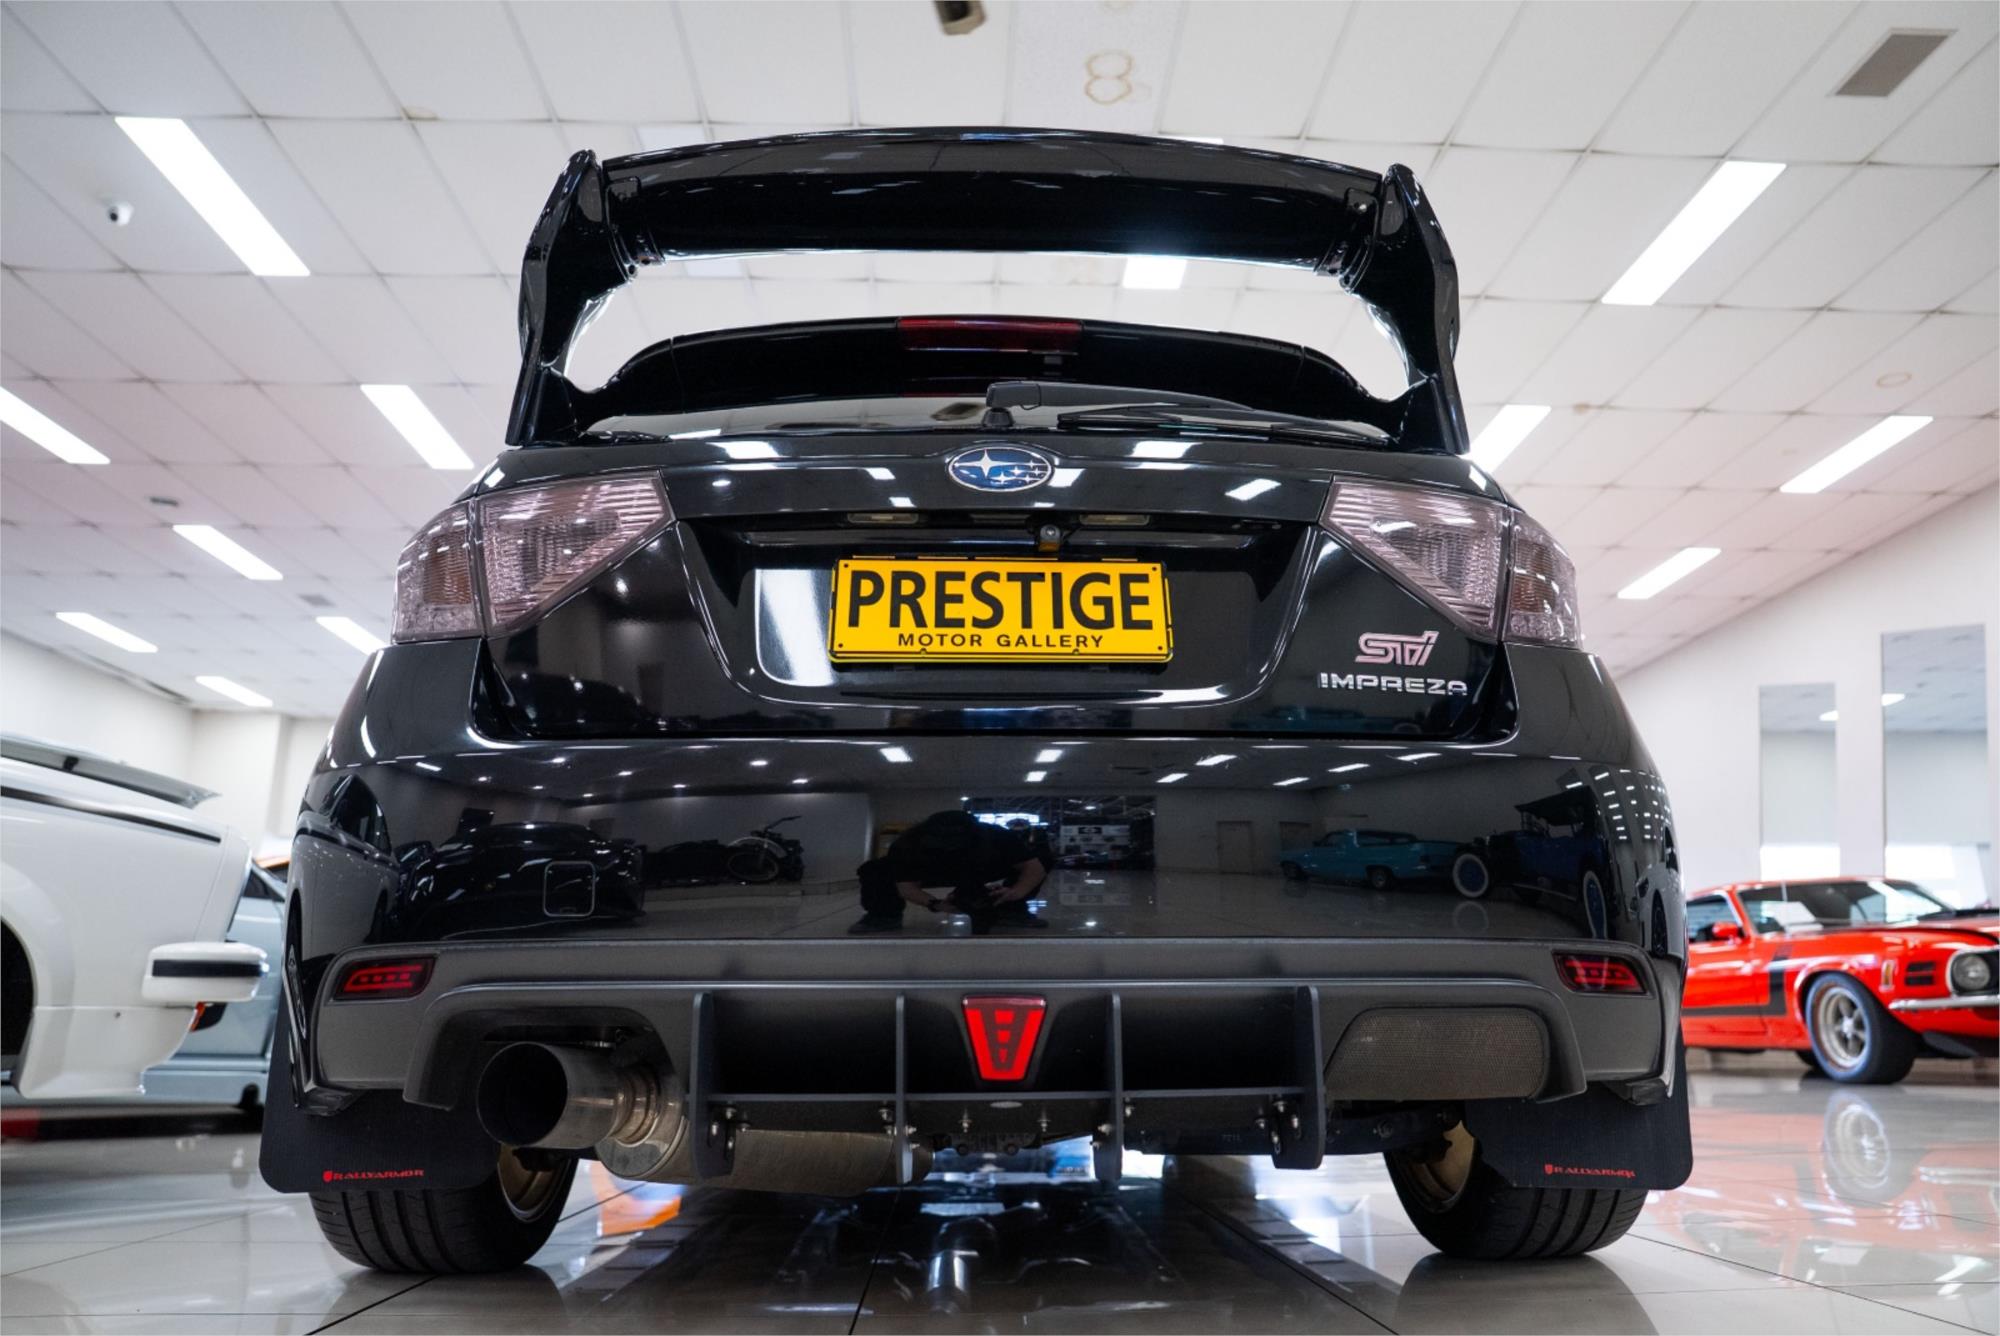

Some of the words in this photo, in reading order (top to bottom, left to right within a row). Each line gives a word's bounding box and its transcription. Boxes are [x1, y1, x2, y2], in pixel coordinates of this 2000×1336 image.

[848, 570, 1154, 631] PRESTIGE
[898, 633, 982, 647] MOTOR
[996, 634, 1104, 649] GALLERY
[1318, 672, 1468, 696] IMPREZA
